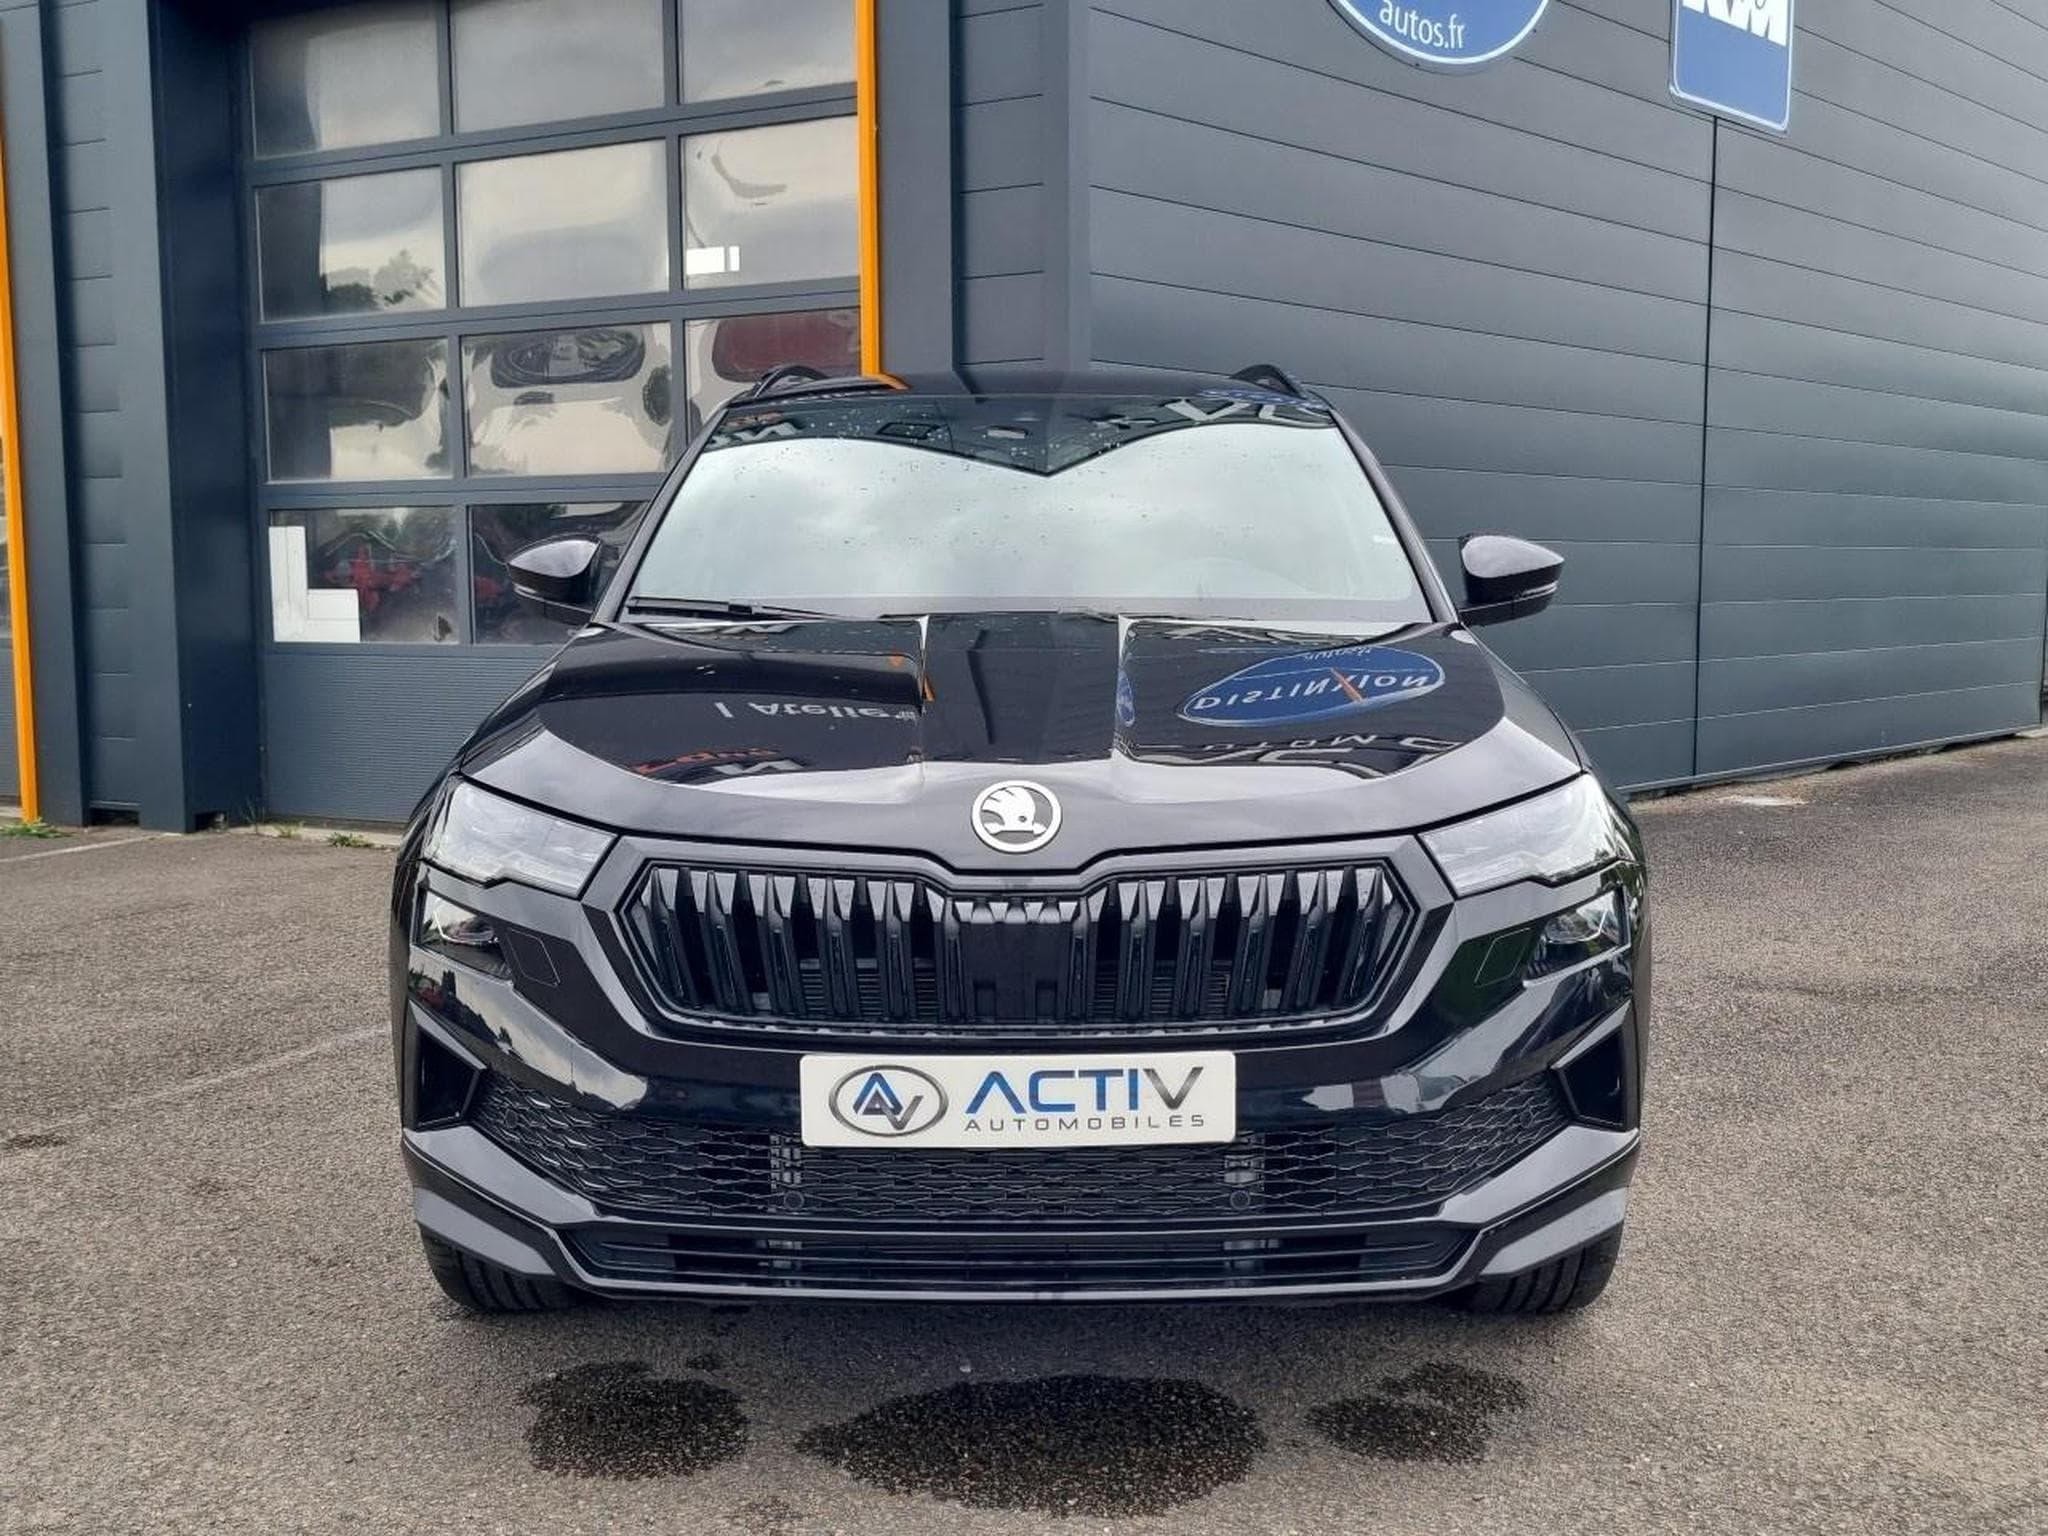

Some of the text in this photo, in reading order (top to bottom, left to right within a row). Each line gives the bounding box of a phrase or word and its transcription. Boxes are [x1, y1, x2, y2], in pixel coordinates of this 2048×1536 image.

[1379, 0, 1465, 49] autos.fr
[965, 1066, 1204, 1114] ACTIV
[964, 1114, 1204, 1132] AUTOMOBILES
